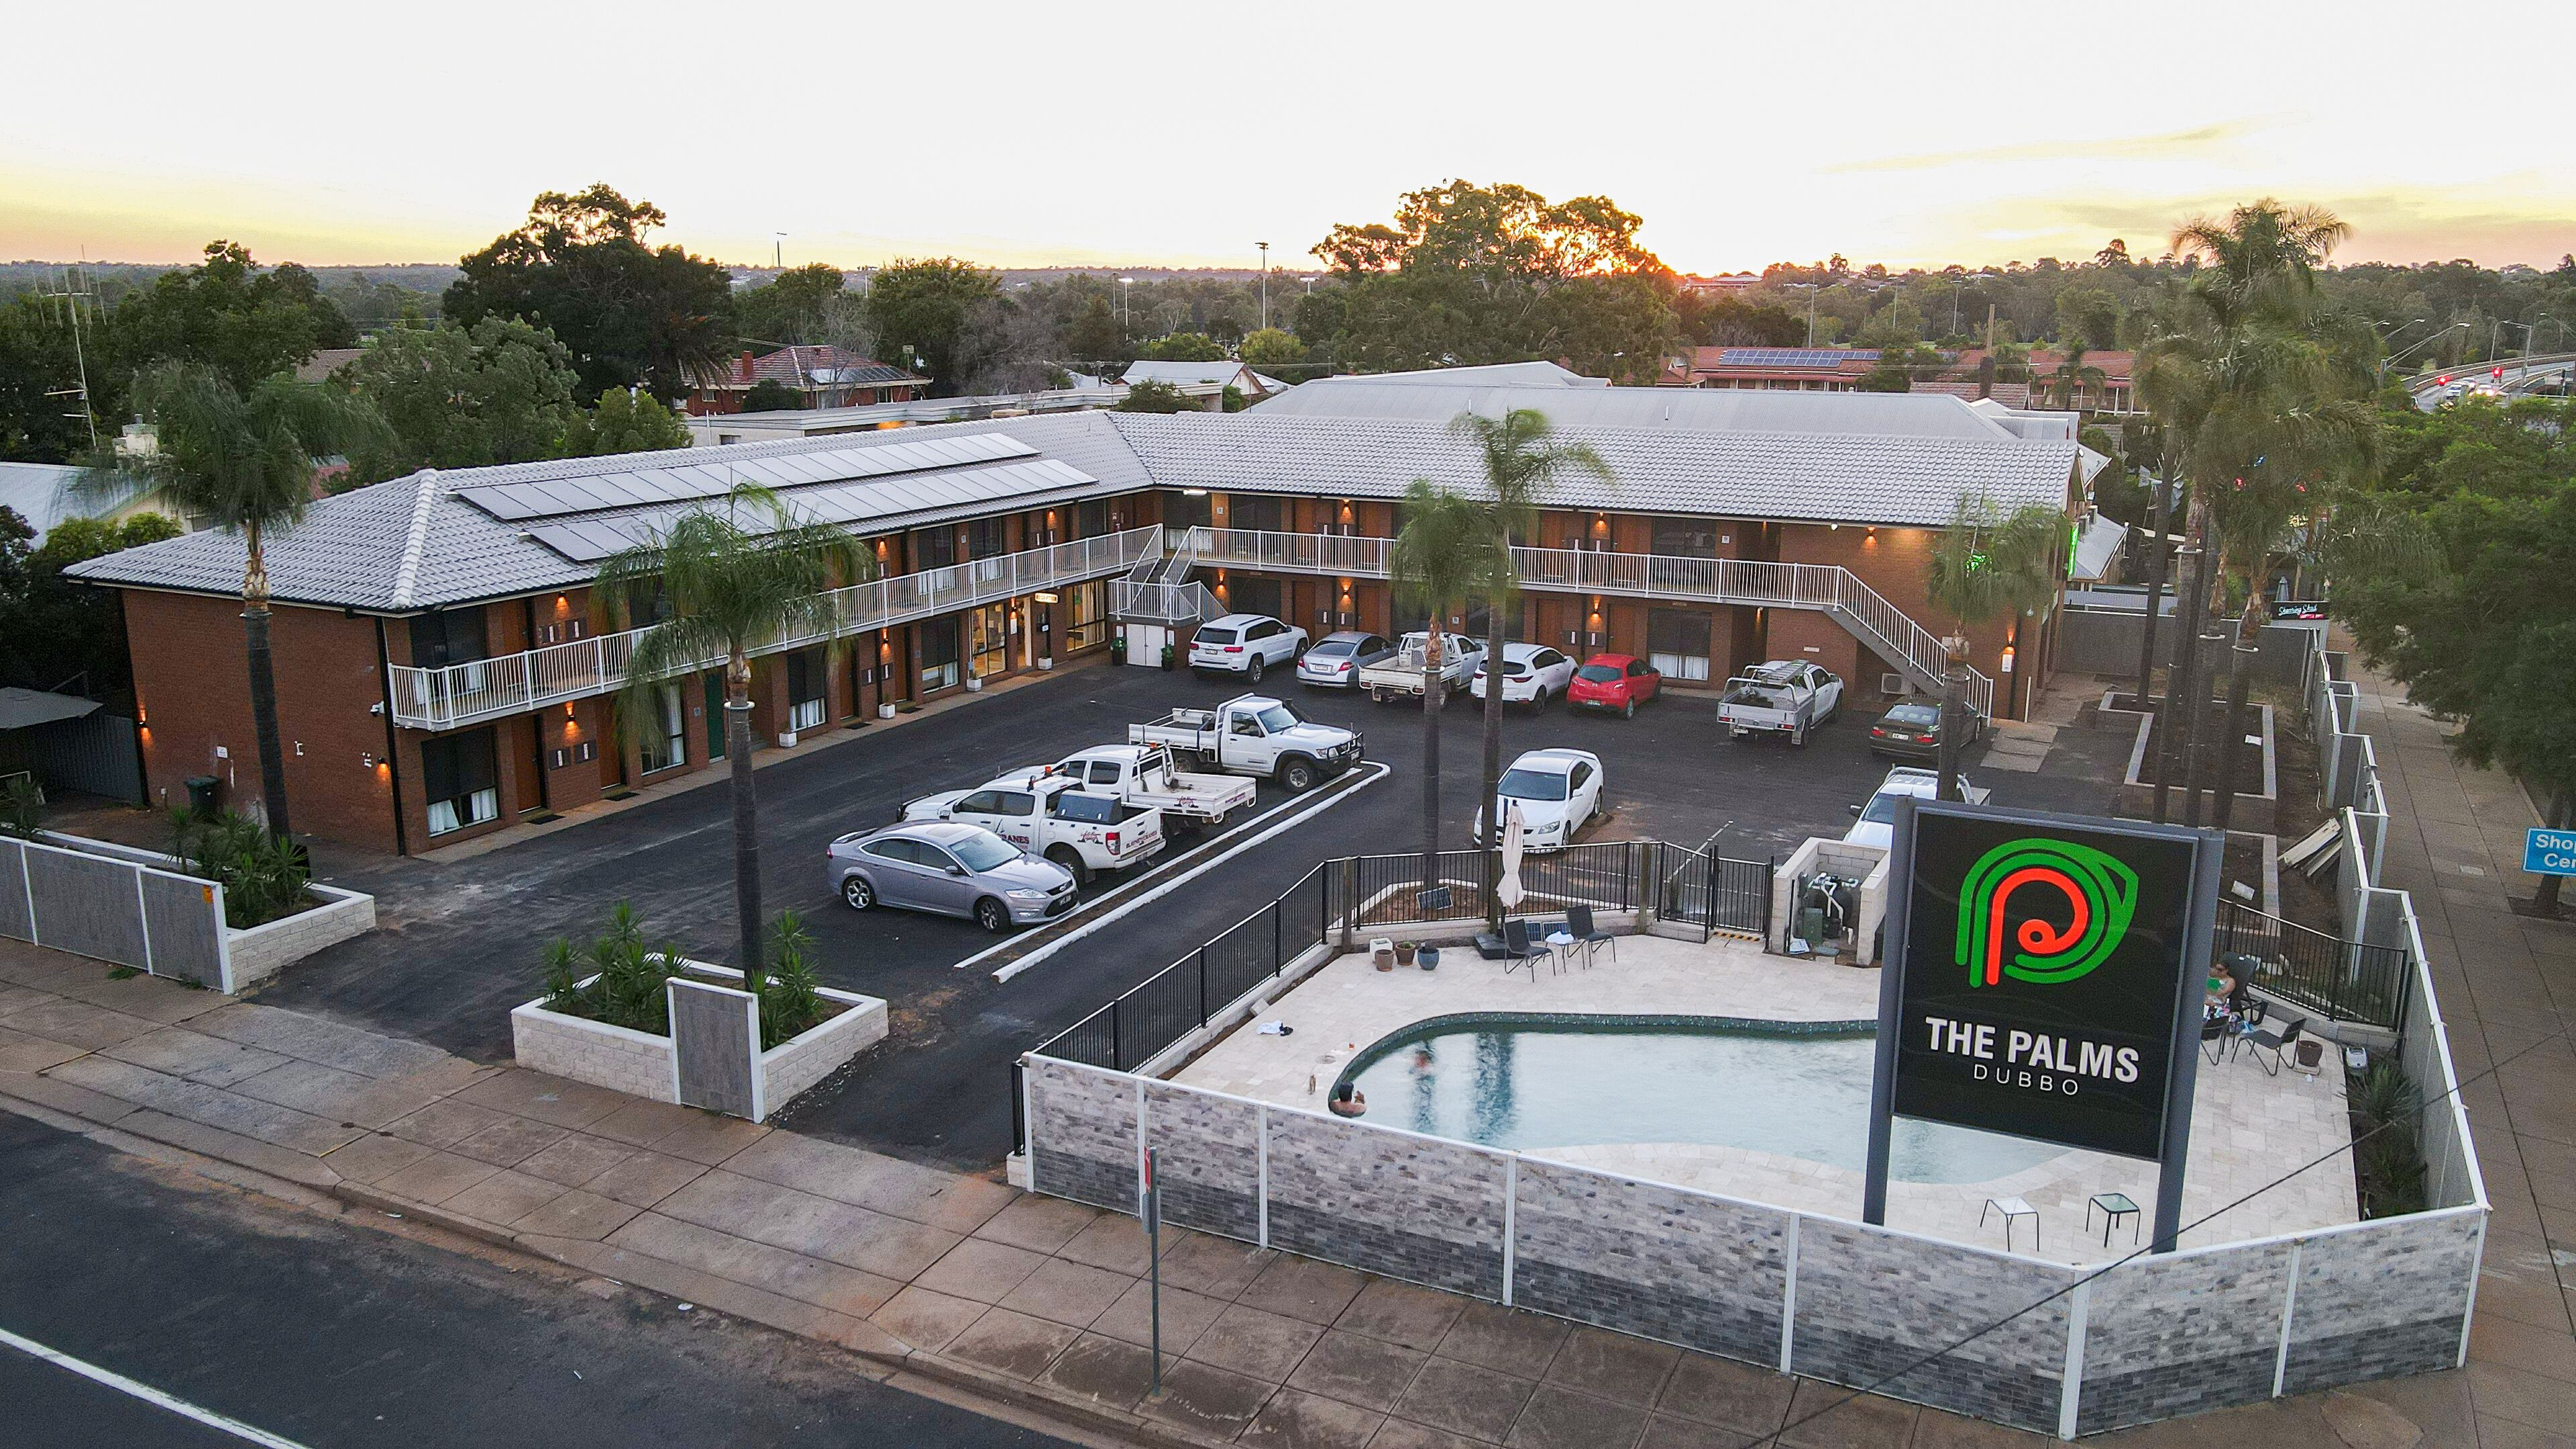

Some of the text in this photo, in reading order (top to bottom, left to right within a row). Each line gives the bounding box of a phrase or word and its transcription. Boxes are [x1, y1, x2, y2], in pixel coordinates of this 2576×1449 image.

[2535, 833, 2576, 855] Sho
[1925, 1016, 2139, 1083] THE PALMS
[1974, 1064, 2078, 1095] DUBBO
